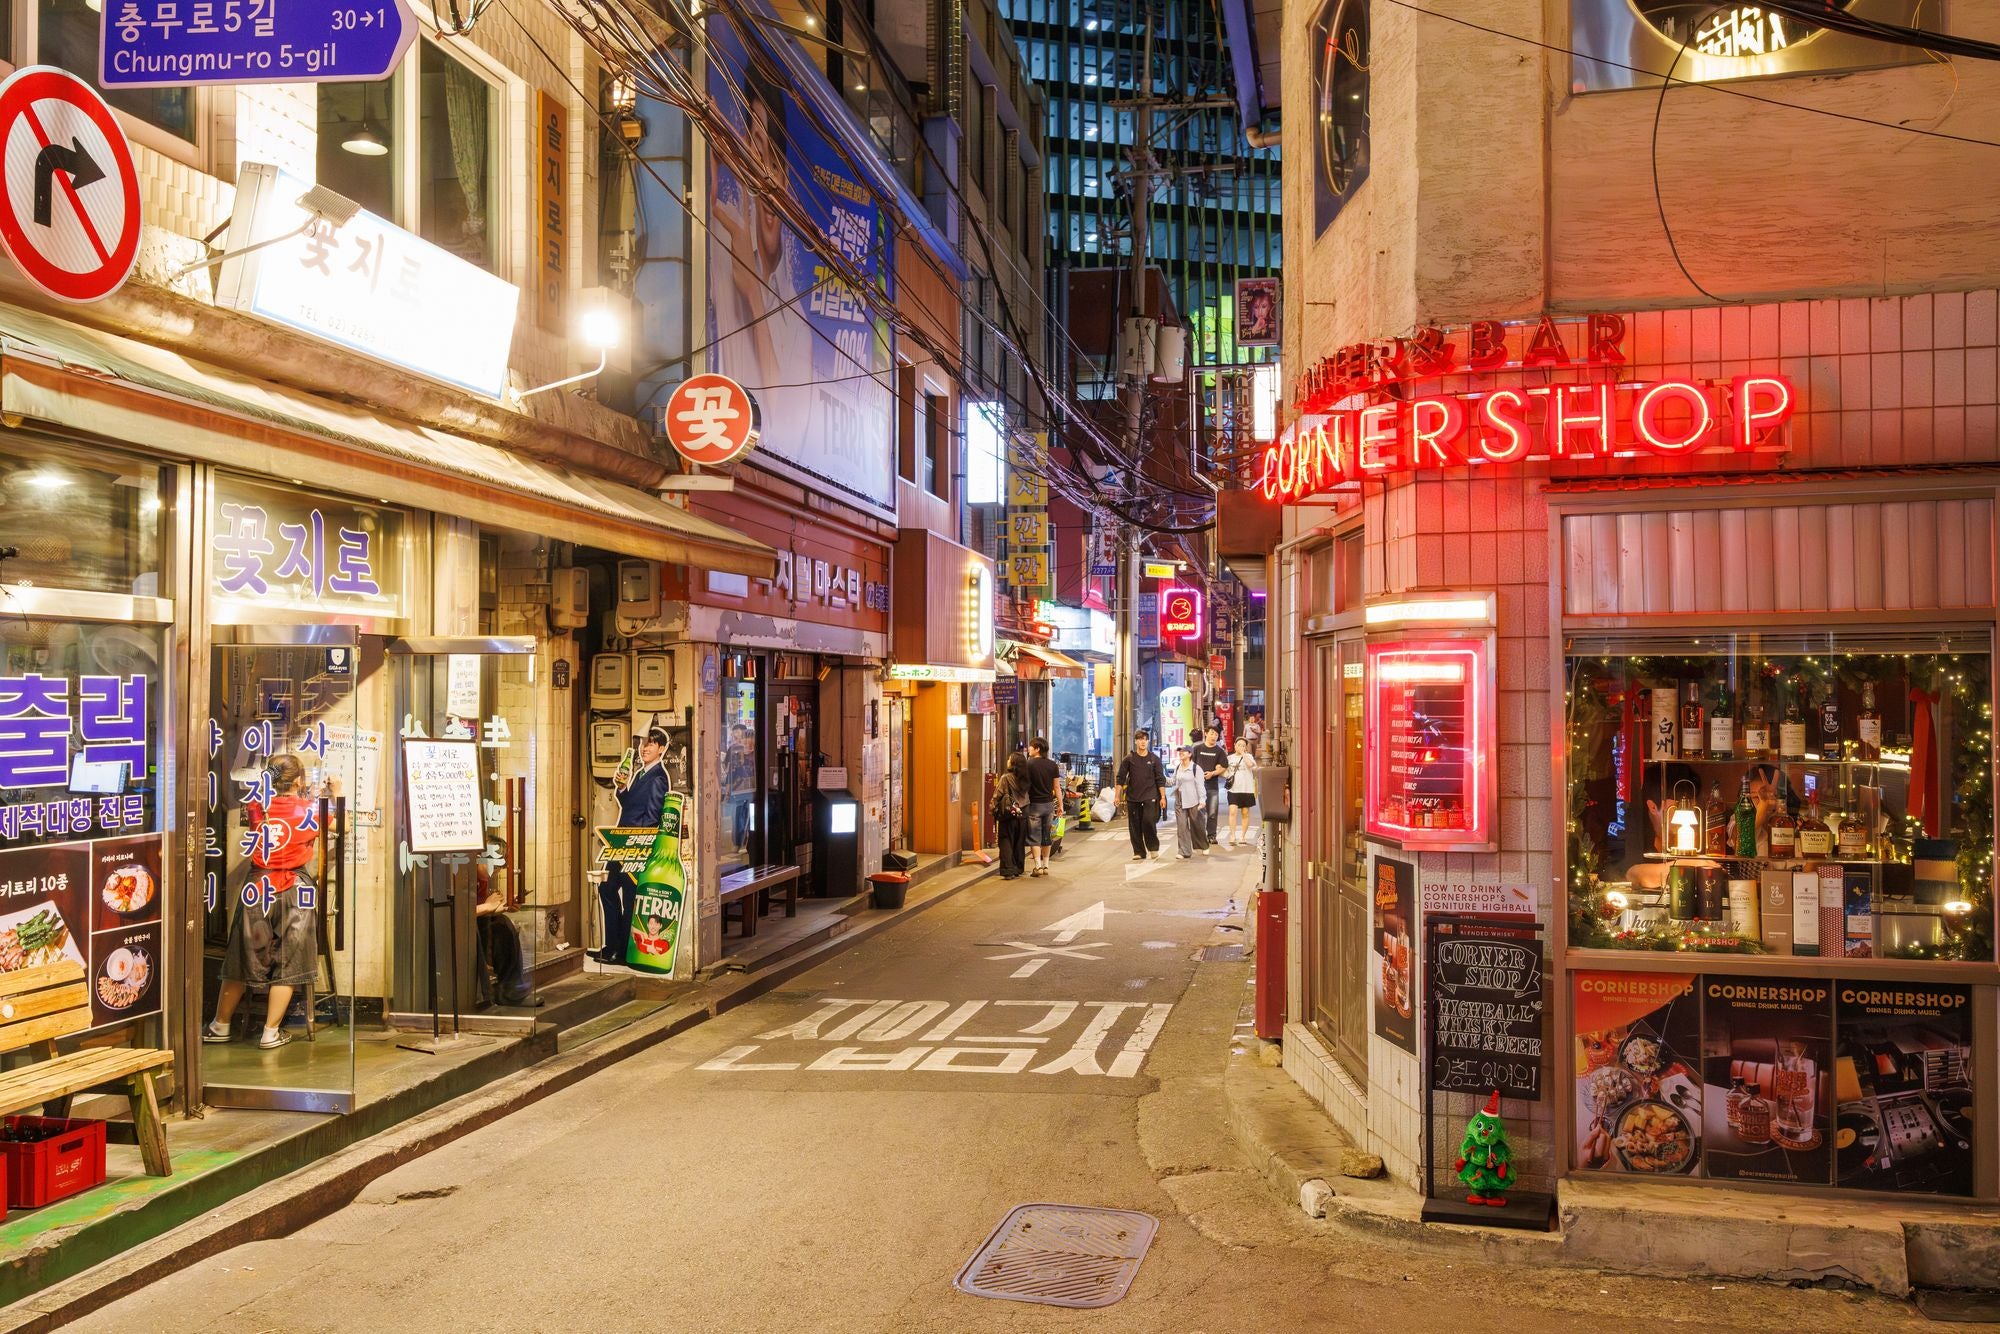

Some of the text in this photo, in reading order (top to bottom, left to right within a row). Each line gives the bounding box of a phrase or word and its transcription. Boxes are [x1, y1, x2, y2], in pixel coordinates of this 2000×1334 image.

[114, 0, 275, 42] 충무로5길
[331, 10, 356, 30] 30
[113, 44, 336, 76] Chungmu-ro 5-gil
[1471, 313, 1627, 370] BAR
[677, 385, 740, 451] 꽃
[819, 388, 867, 472] TERRA
[213, 502, 380, 599] 꽃지로
[557, 673, 566, 686] 16
[0, 673, 147, 789] 출력
[1656, 717, 1675, 756] 白州
[0, 794, 144, 840] 제작대행 전문
[240, 719, 278, 918] 이자카야
[626, 834, 657, 846] 강력한
[600, 847, 653, 861] 리얼탄산
[620, 861, 647, 873] 100%
[0, 873, 69, 899] 키토리 10종
[1424, 884, 1503, 893] HOW TO DRINK
[635, 894, 680, 922] TERRA
[1424, 893, 1506, 902] CORNERSHOP'S
[1424, 901, 1533, 912] SIGNITURE HIGHBALL
[1439, 942, 1526, 970] CORNER
[1465, 967, 1522, 989] SHOP
[1580, 979, 1694, 997] CORNERSHOP
[1708, 984, 1827, 1002] CORNERSHOP
[1841, 989, 1966, 1009] CORNERSHOP
[1438, 1000, 1534, 1022] HIGHBALL
[1731, 1001, 1757, 1009] DINNER
[1780, 1003, 1804, 1011] MUSIC
[1437, 1016, 1513, 1036] WHISKY
[1436, 1030, 1480, 1049] WINE
[1480, 1061, 1537, 1092] 있어요!
